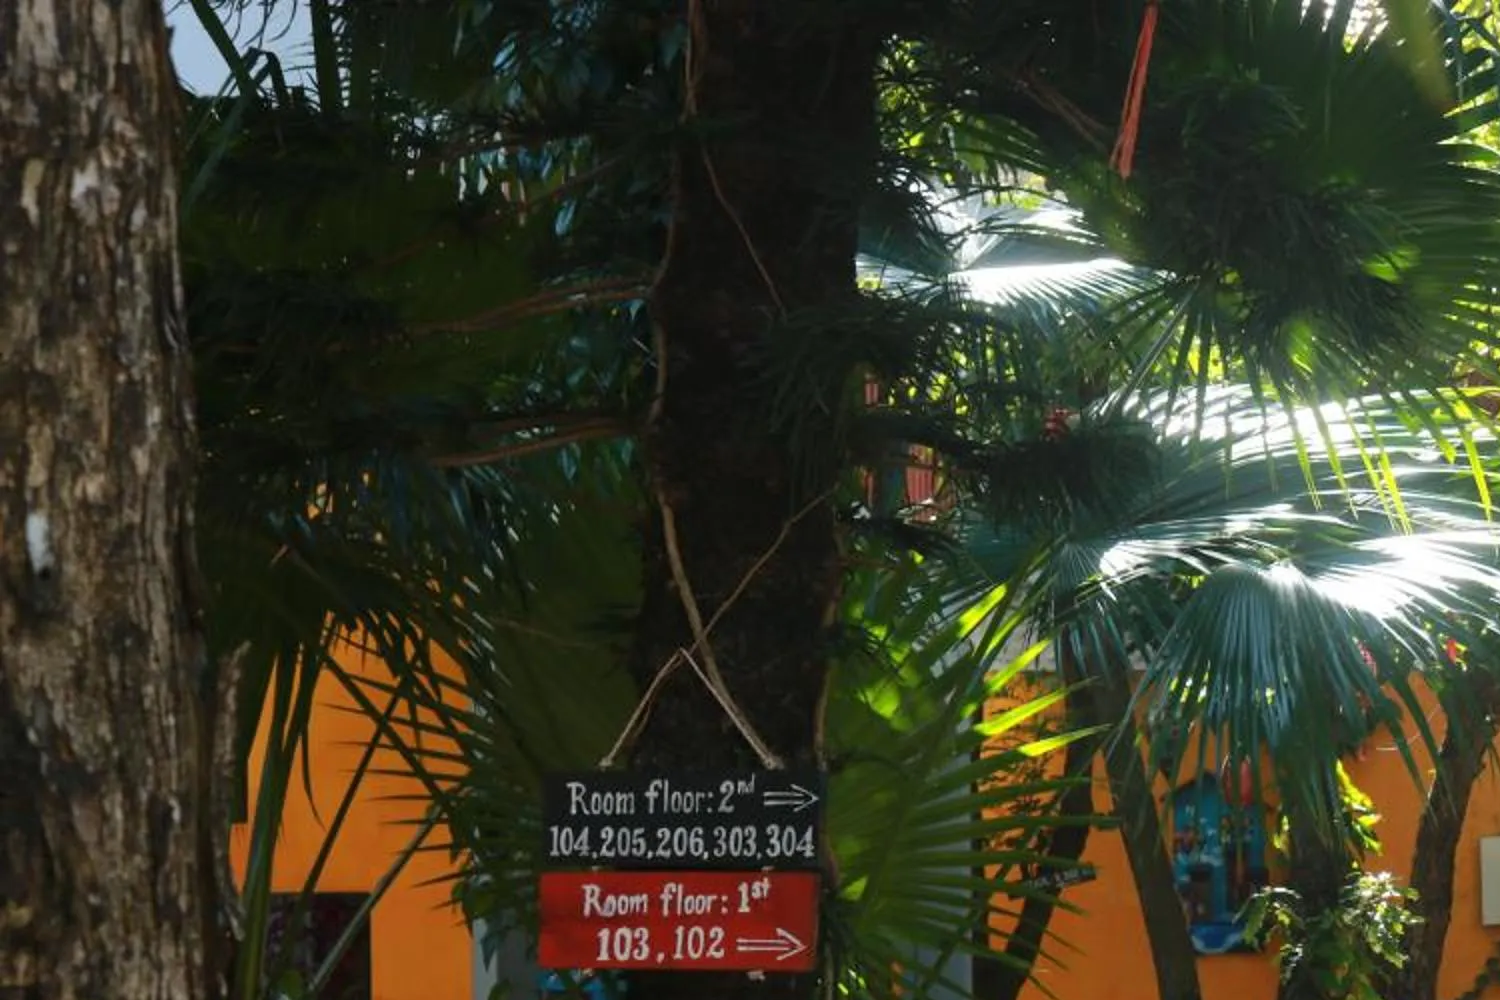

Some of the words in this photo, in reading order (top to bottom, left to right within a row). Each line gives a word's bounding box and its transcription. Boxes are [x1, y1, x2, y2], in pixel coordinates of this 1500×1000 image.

[567, 781, 635, 815] Room
[645, 779, 713, 814] floor:
[718, 773, 755, 813] 2nd
[581, 883, 648, 917] Room
[660, 883, 728, 916] floor:
[737, 876, 772, 913] 1st
